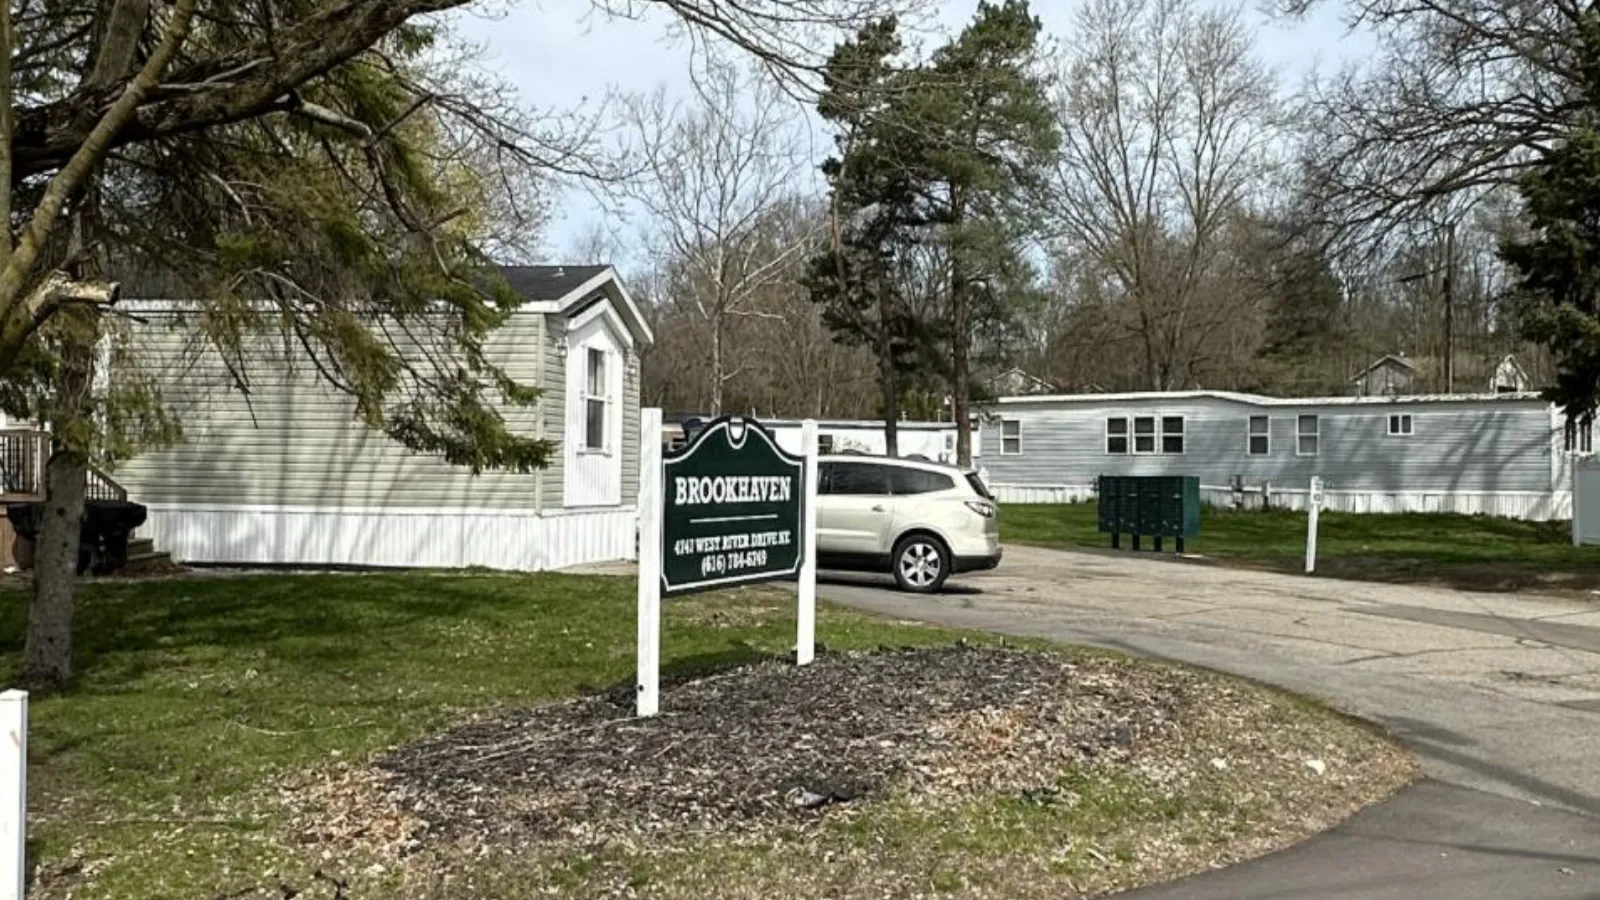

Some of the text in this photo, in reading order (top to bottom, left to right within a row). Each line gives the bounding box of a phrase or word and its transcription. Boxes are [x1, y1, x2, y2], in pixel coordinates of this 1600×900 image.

[675, 476, 791, 505] BROOKHAVEN
[696, 536, 720, 553] WEST
[722, 534, 749, 550] RIVER
[750, 532, 778, 547] DRIVE
[701, 554, 726, 577] (616)
